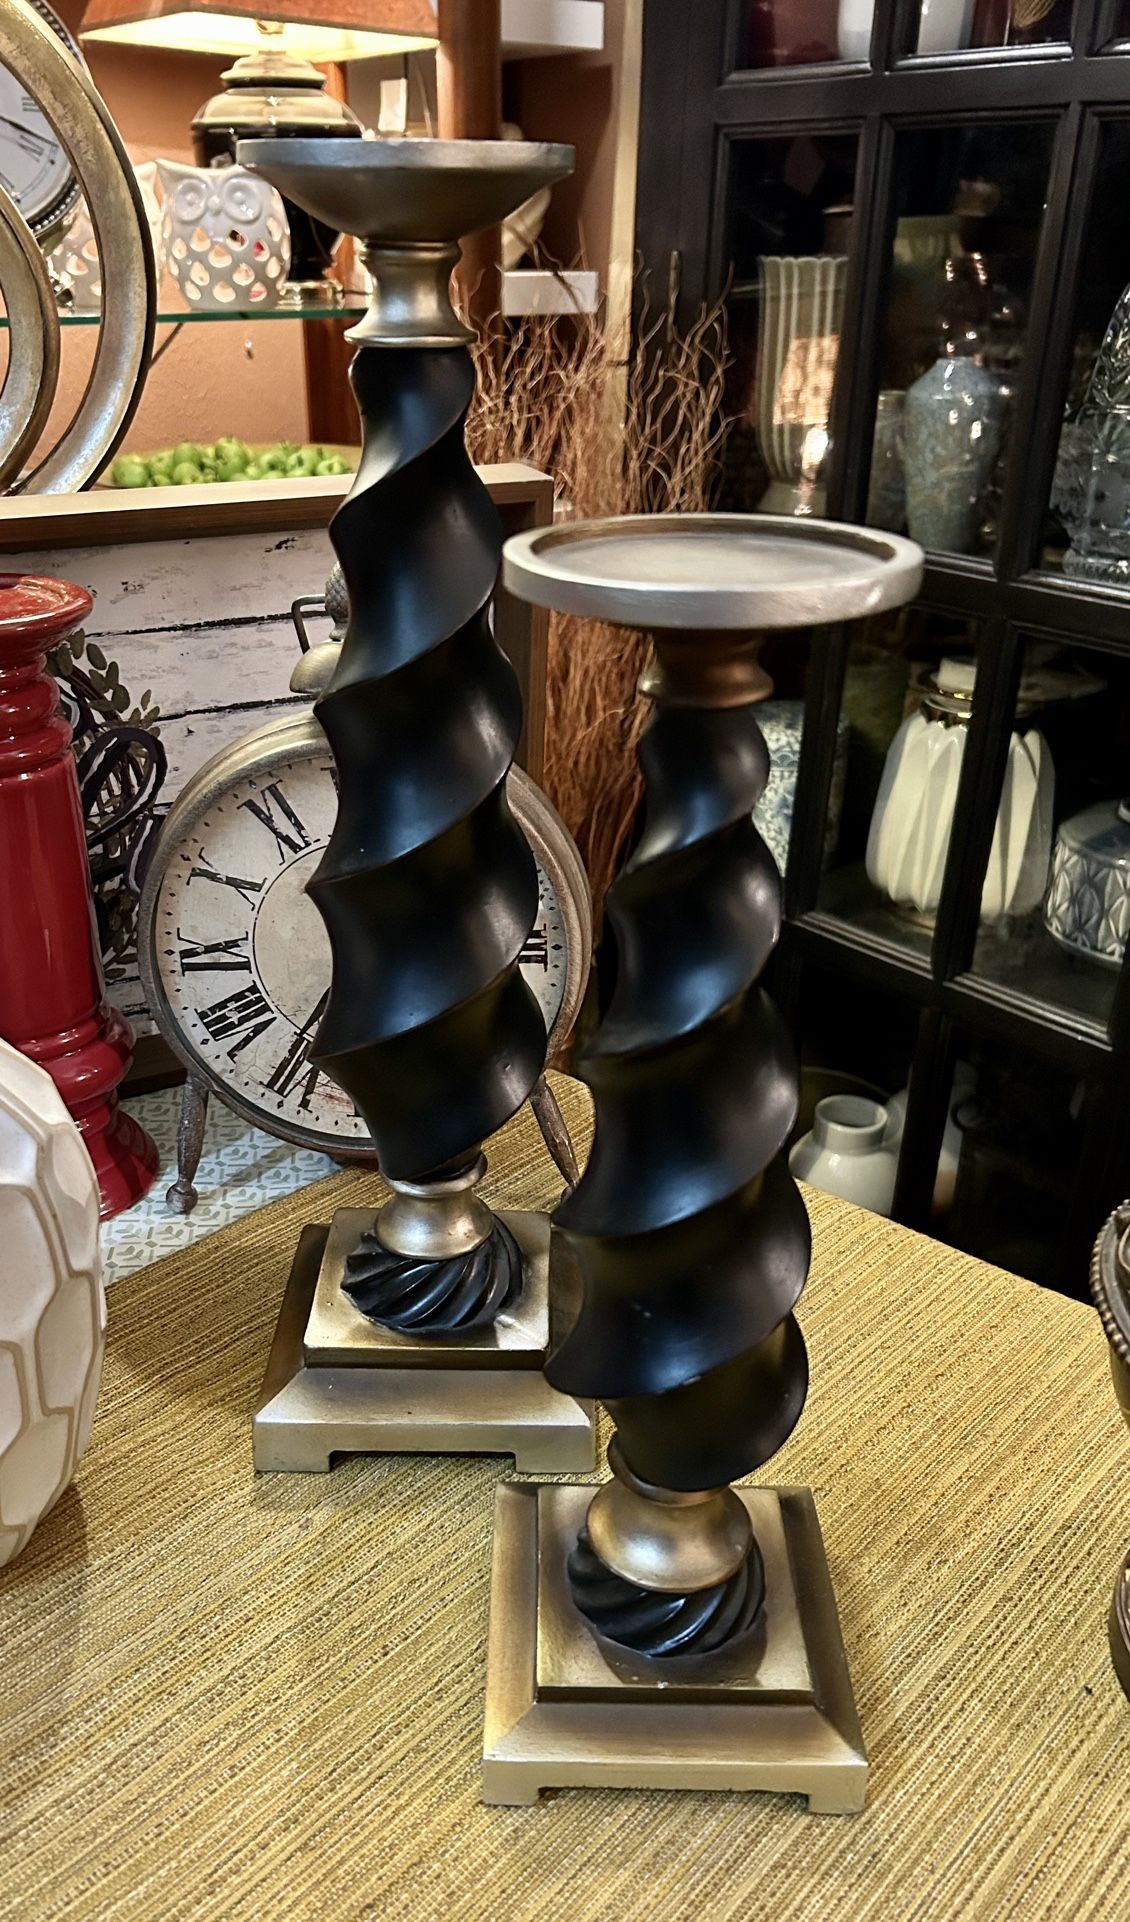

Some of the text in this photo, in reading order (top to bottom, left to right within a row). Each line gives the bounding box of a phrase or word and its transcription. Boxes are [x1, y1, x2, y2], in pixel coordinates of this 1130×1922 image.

[236, 779, 320, 866] XI
[186, 846, 268, 911] X
[177, 927, 252, 976] IX
[194, 979, 277, 1064] VIII
